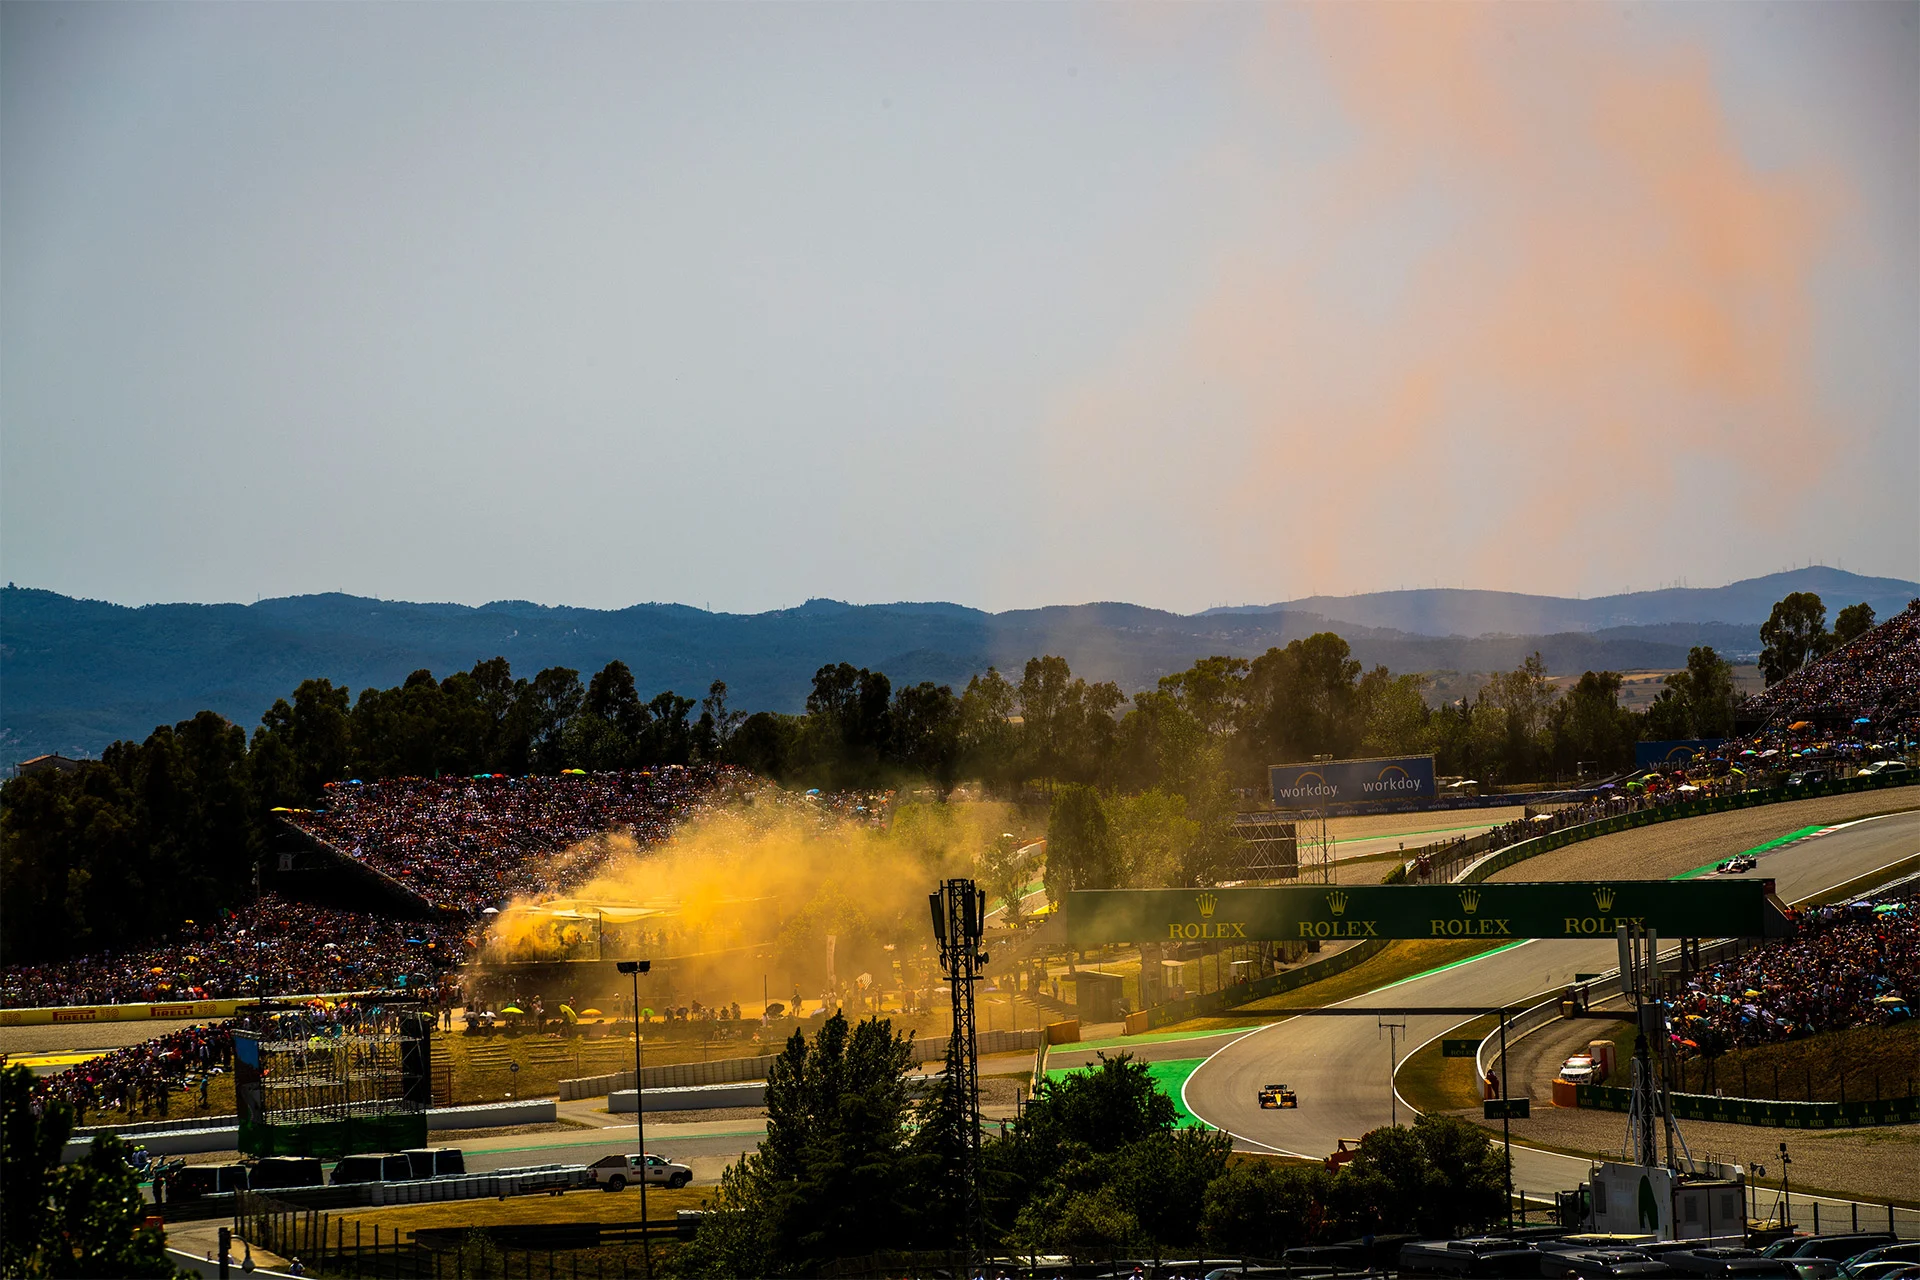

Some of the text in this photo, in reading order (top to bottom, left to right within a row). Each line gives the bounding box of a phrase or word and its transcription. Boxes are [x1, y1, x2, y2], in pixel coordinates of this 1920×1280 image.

[1280, 776, 1421, 798] workday workday
[1168, 923, 1247, 939] ROLEX
[1298, 921, 1379, 937] ROLEX
[1430, 919, 1511, 935] ROLEX
[53, 1010, 96, 1021] PIRELLI
[150, 1005, 194, 1017] PIRELLI
